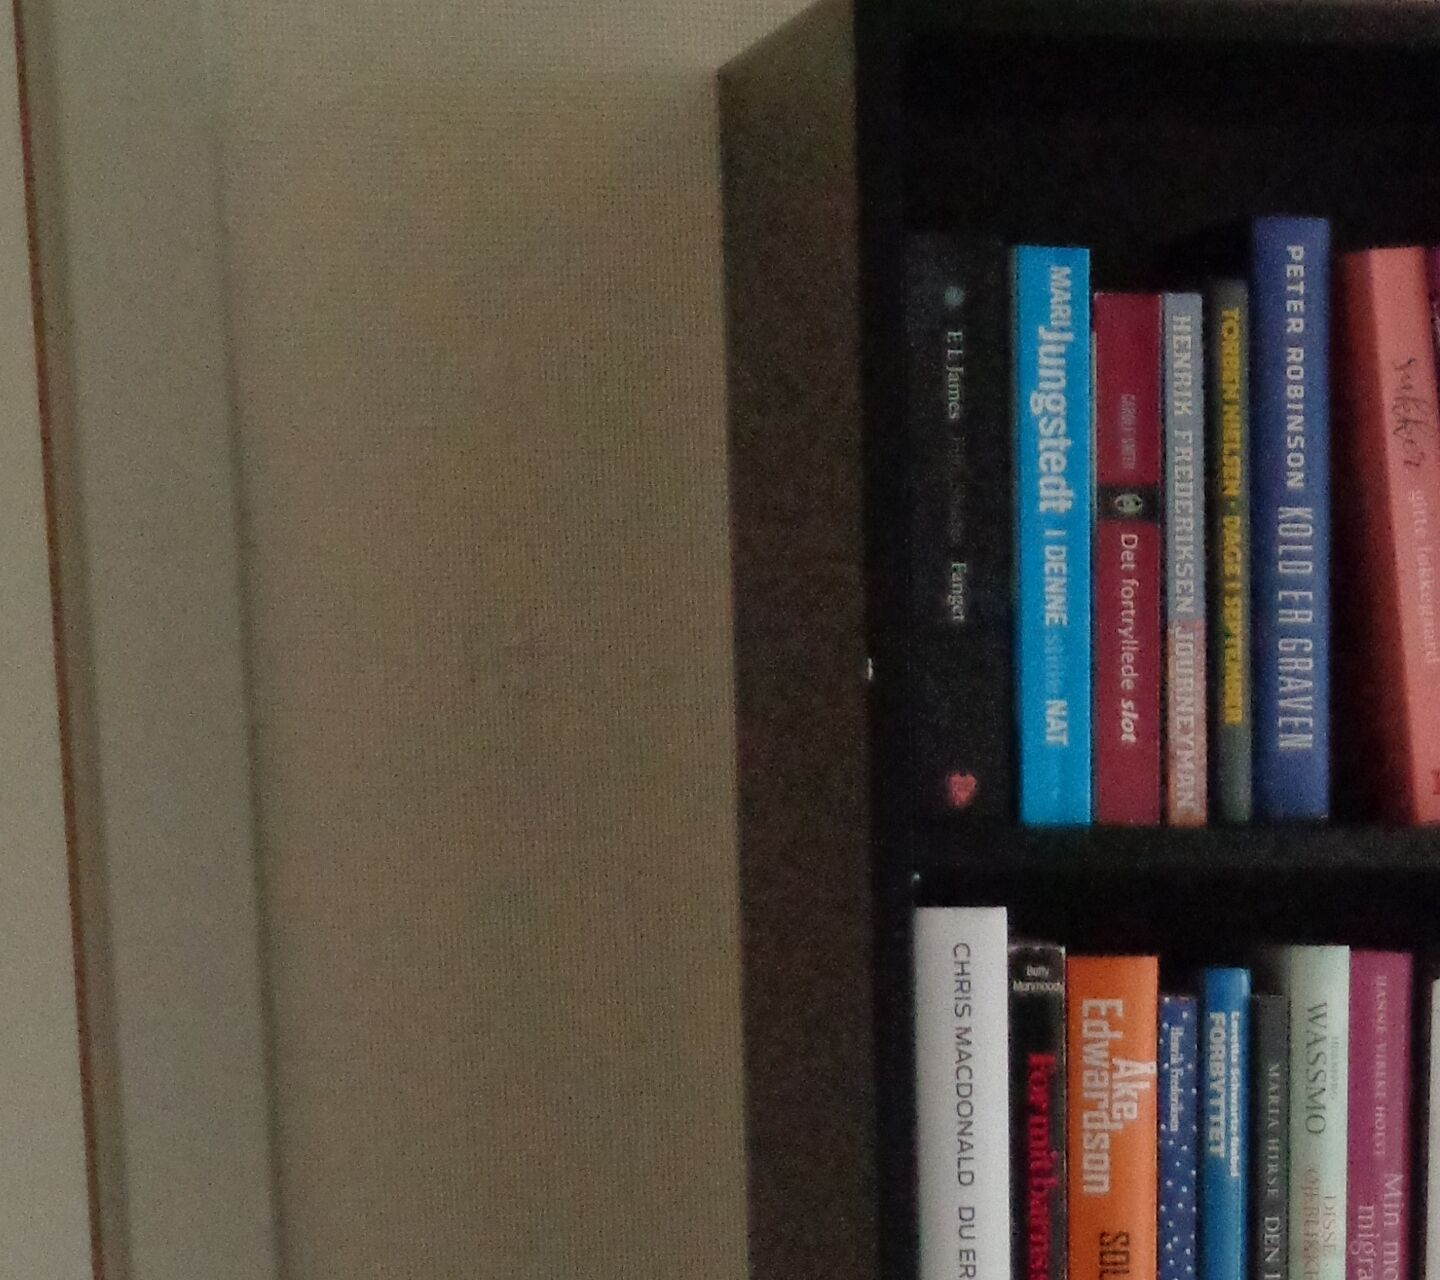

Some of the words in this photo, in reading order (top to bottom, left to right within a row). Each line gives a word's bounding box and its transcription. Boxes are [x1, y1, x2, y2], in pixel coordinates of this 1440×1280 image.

[1049, 265, 1073, 327] MARI
[1286, 244, 1305, 334] PETER
[942, 366, 964, 420] James
[1172, 315, 1193, 417] HENRIK
[1030, 327, 1074, 514] Jungstedt
[1286, 346, 1305, 490] ROBINSON
[1120, 533, 1140, 573] Det
[1173, 429, 1195, 614] FREDERIKSEN
[1277, 506, 1313, 574] KOLD
[945, 561, 968, 622] Fanget
[1043, 545, 1069, 627] DENNE
[1277, 590, 1314, 626] ER
[1115, 576, 1141, 691] fortryllede
[1044, 699, 1069, 747] NAT
[1120, 698, 1141, 746] slot
[1174, 625, 1197, 810] JOURNEYMAN
[1277, 636, 1314, 751] GRAVEN
[953, 942, 973, 1018] CHRIS
[1081, 999, 1124, 1195] Edwardson
[1105, 1058, 1156, 1122] Åke
[1208, 1011, 1226, 1159] FORBYTTET
[1265, 1062, 1281, 1127] MARIA
[1302, 1002, 1329, 1135] WASSMO
[954, 1025, 975, 1188] MACDONALD
[1265, 1137, 1280, 1198] HIRSE
[1381, 1172, 1404, 1230] Min
[957, 1205, 978, 1241] DU
[1263, 1214, 1284, 1262] DEN
[958, 1247, 979, 1280] ER
